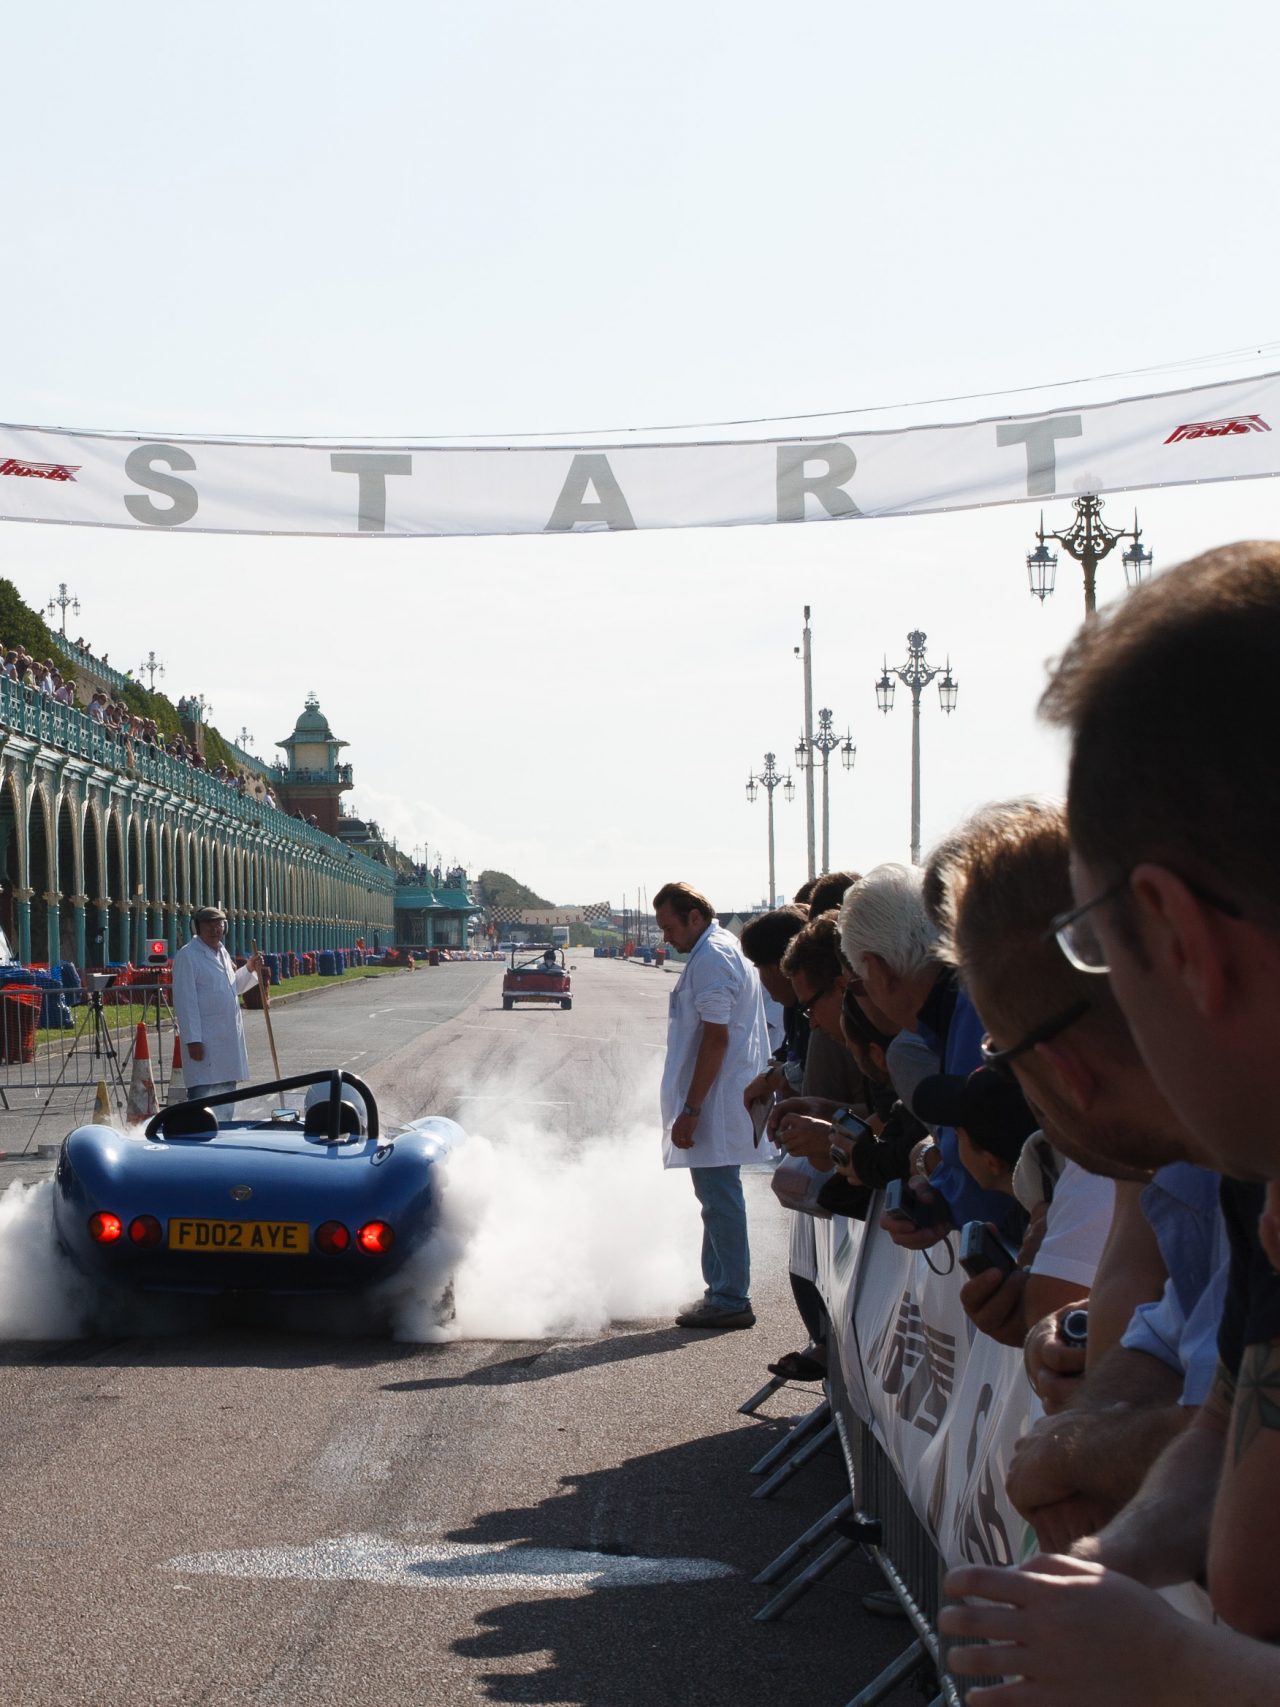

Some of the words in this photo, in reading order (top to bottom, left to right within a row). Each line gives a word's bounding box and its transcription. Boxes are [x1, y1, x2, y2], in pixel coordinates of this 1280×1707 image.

[124, 414, 1082, 530] START
[525, 914, 581, 924] FINISH
[179, 1222, 243, 1247] FD02
[250, 1225, 298, 1248] AYE
